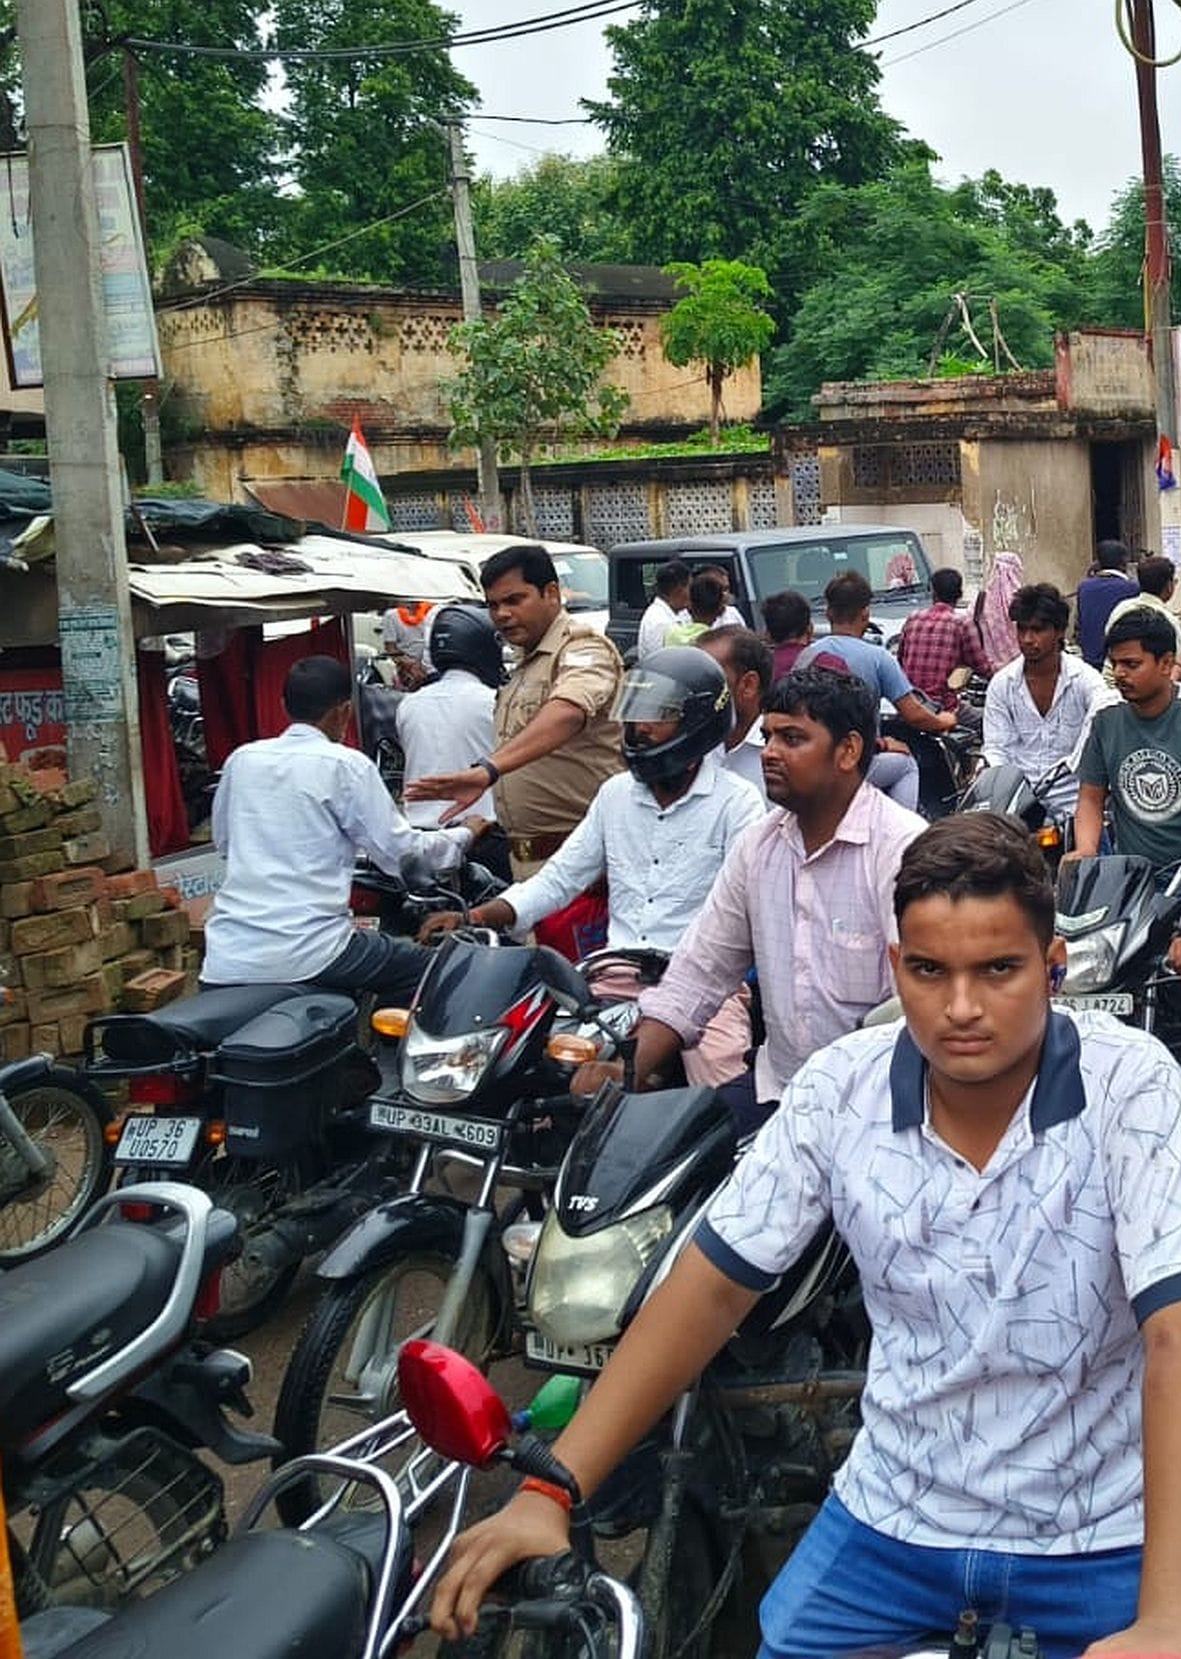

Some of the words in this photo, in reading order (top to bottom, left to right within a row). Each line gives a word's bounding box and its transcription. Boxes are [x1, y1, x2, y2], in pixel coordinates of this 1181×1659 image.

[385, 1110, 406, 1125] UP
[136, 1119, 158, 1138] UP
[164, 1120, 187, 1139] 36
[568, 1195, 599, 1211] TVS
